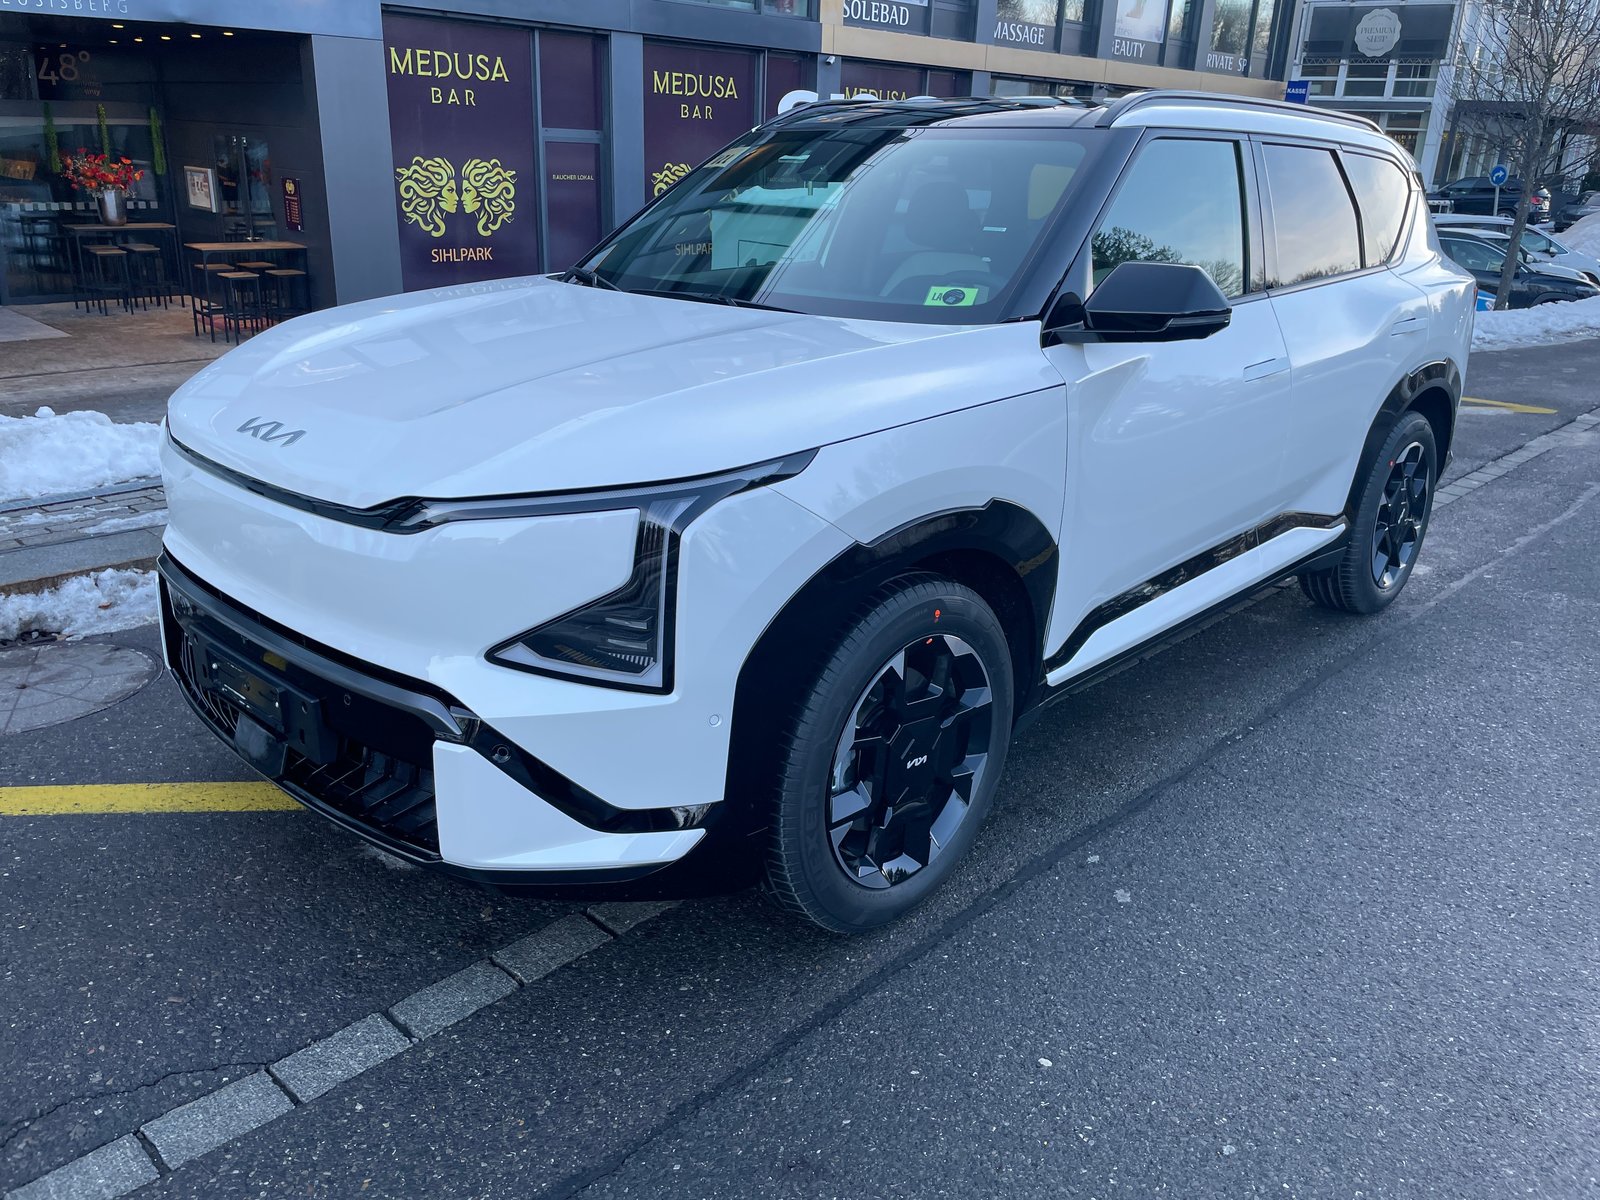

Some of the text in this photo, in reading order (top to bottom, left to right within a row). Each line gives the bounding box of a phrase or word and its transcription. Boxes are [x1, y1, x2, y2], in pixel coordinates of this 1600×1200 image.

[843, 0, 909, 26] SOLEBAD
[1360, 26, 1396, 35] PREMIUM
[389, 46, 510, 82] MEDUSA
[653, 70, 739, 100] MEDUSA
[1286, 87, 1306, 95] KASSE
[430, 87, 476, 106] BAR
[681, 104, 713, 120] BAR
[431, 247, 493, 263] SIHLPARK
[236, 416, 307, 447] KIA
